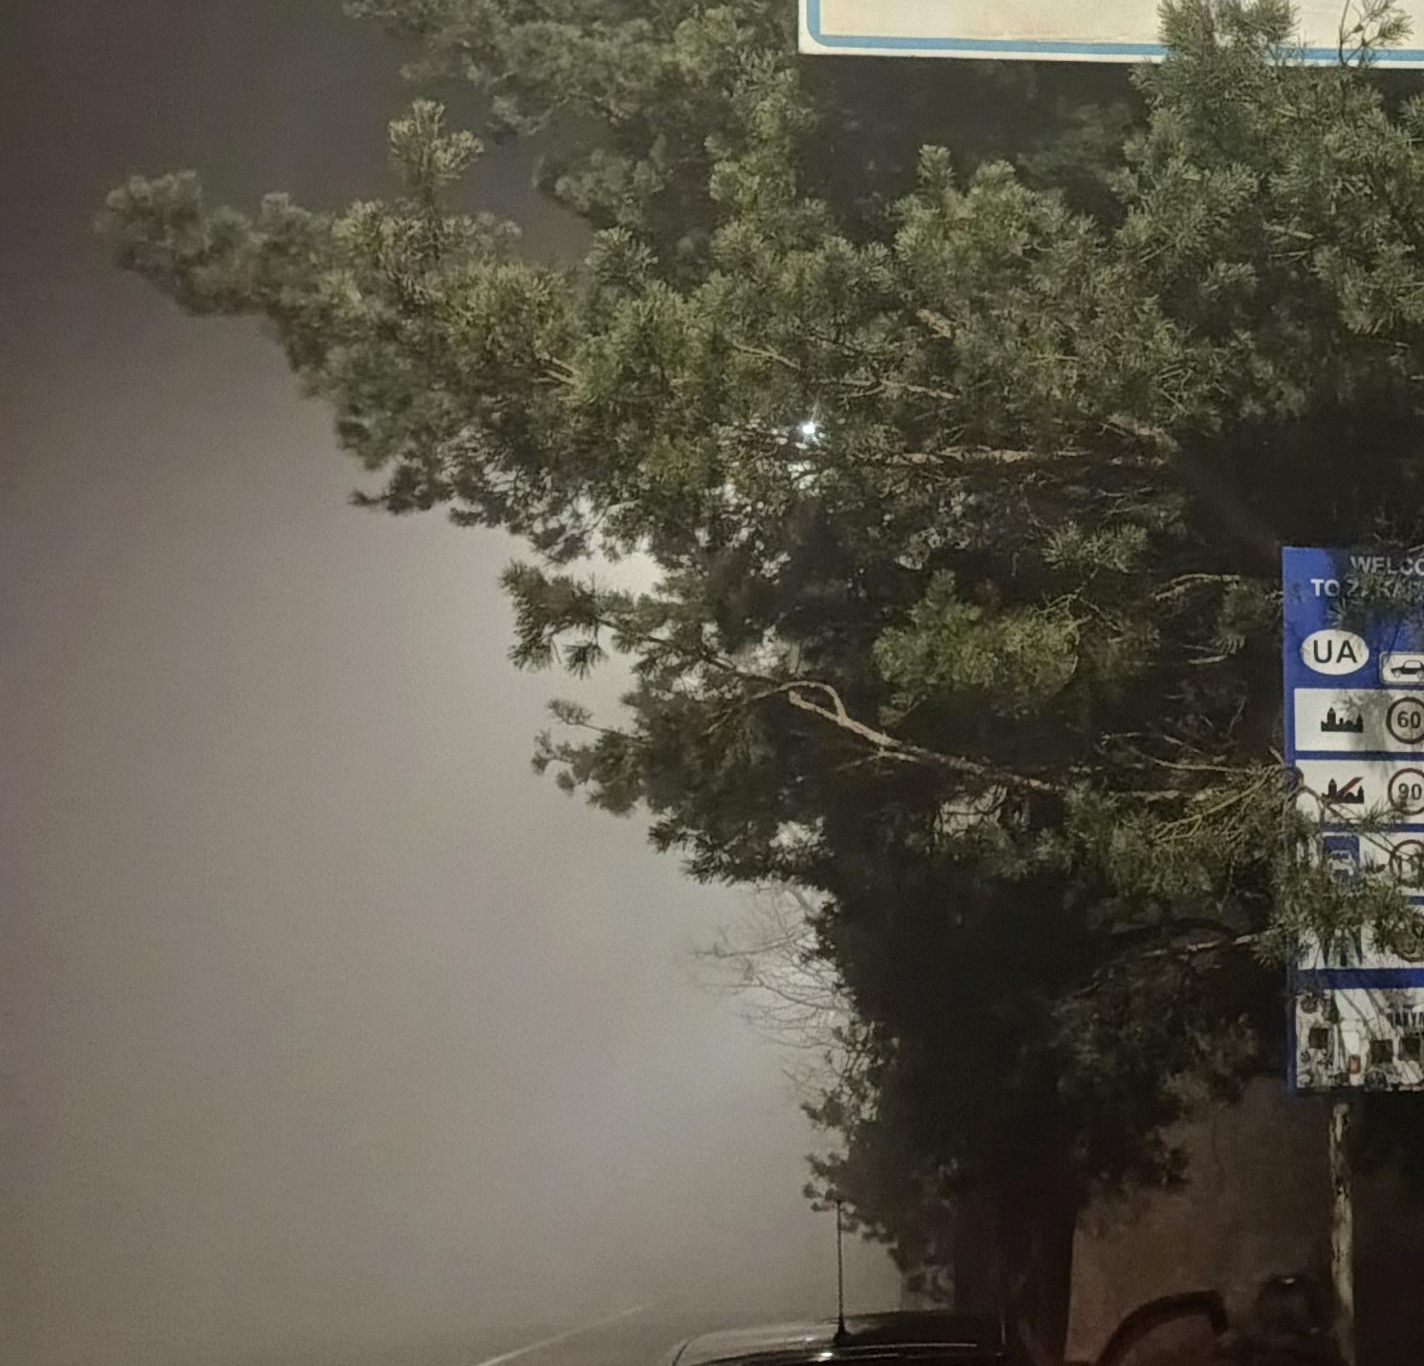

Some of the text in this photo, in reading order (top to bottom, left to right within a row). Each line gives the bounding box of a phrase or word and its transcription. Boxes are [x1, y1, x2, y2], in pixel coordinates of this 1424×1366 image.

[1310, 577, 1340, 598] TO
[1313, 638, 1358, 665] UA
[1396, 710, 1422, 730] 60
[1398, 783, 1423, 802] 90
